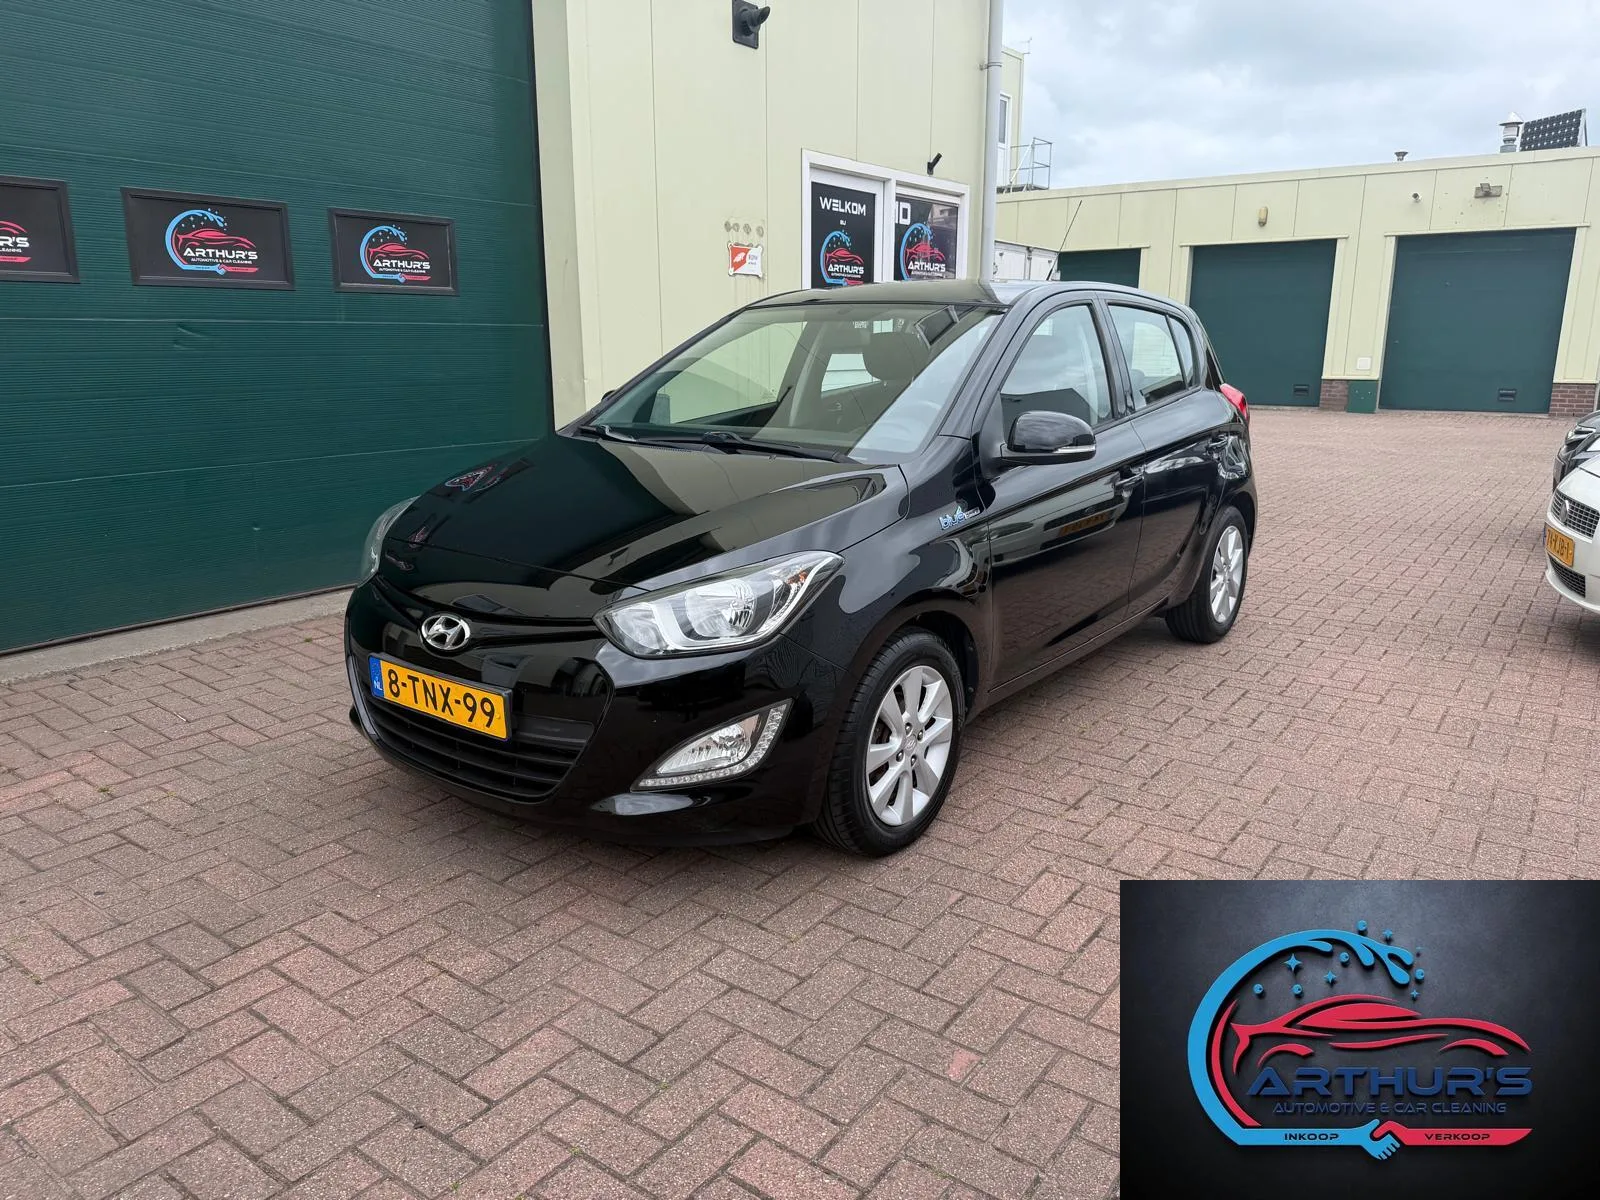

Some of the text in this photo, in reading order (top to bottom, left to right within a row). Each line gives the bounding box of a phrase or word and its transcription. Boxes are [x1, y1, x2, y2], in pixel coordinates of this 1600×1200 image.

[819, 196, 867, 216] WELKOM
[183, 247, 258, 259] ARTHUR'S
[373, 259, 430, 269] ARTHUR'S
[828, 264, 865, 275] ARTHUR'S
[908, 261, 946, 273] ARTHUR'S
[373, 668, 495, 728] NL 8-TNX-99
